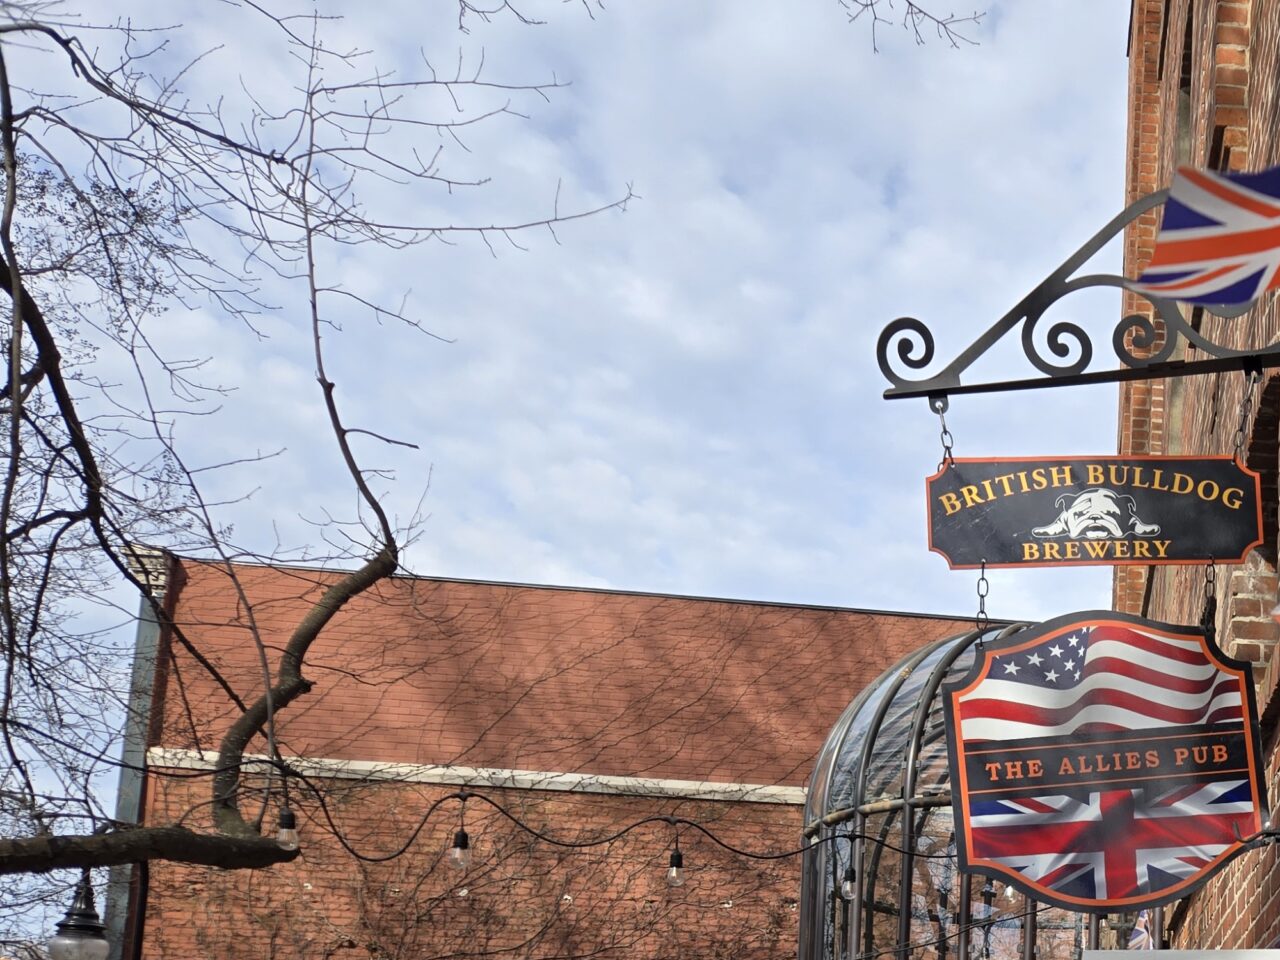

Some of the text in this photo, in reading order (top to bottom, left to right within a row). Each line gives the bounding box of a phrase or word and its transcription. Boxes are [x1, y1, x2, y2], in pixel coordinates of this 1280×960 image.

[938, 462, 1245, 516] BRITISH BULLDOG
[1022, 540, 1171, 561] BREWERY
[985, 744, 1228, 781] THE ALLIES PUB
